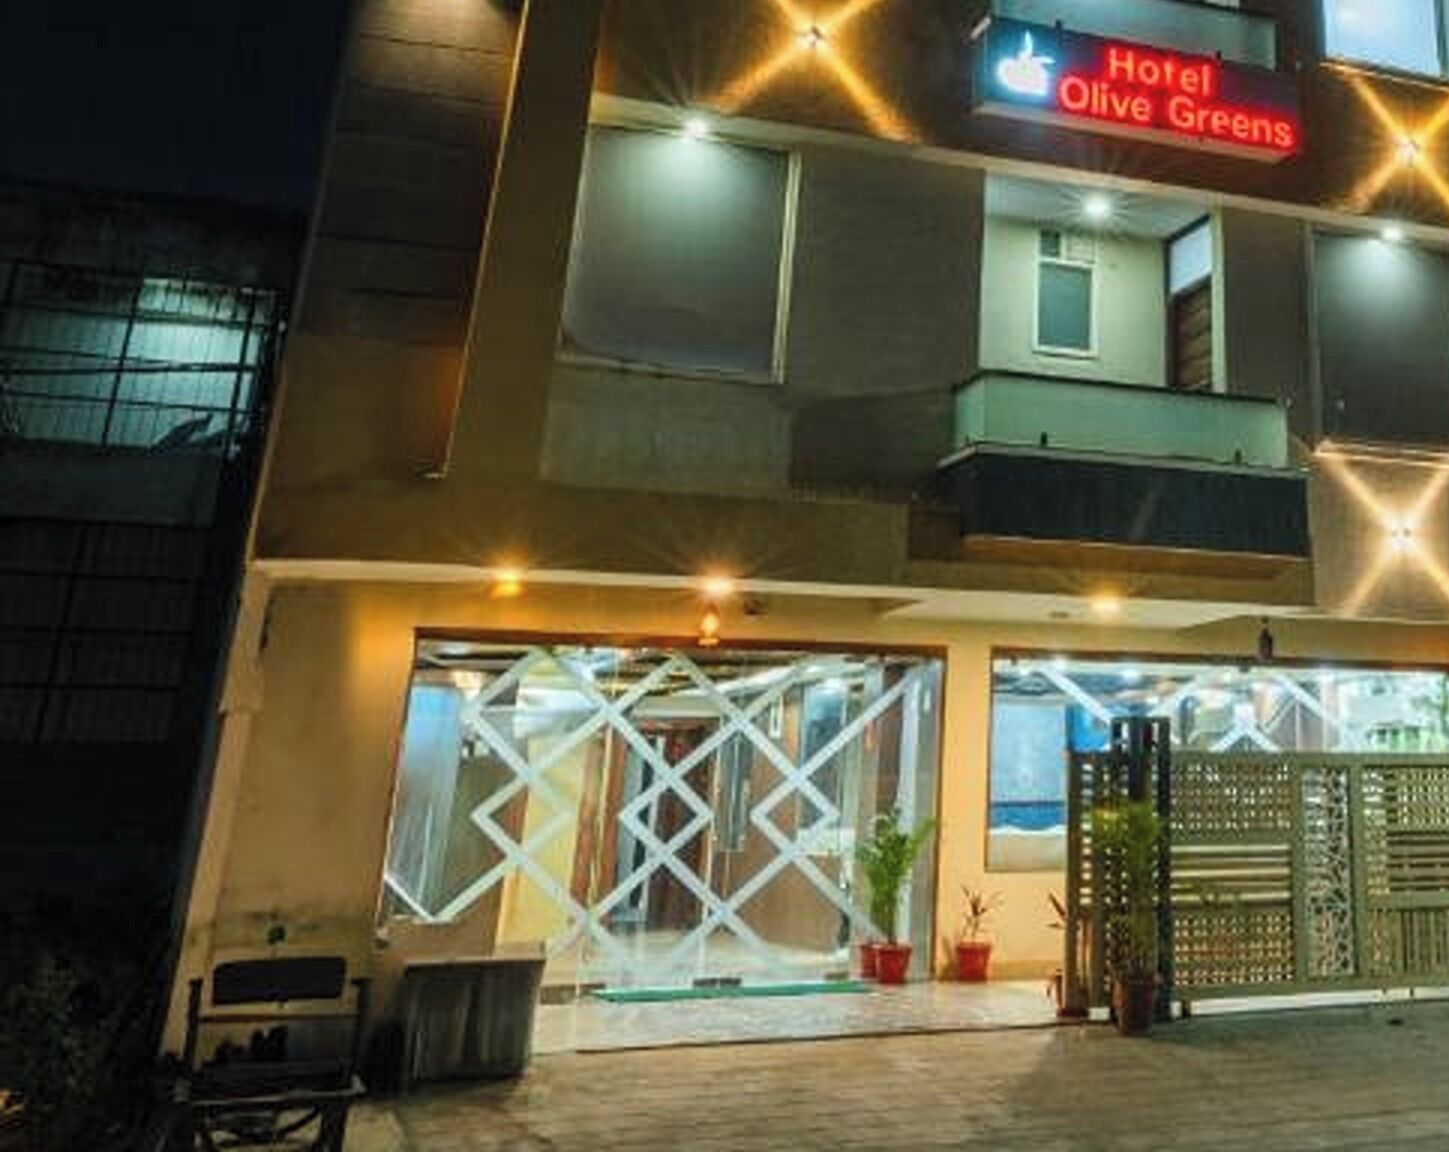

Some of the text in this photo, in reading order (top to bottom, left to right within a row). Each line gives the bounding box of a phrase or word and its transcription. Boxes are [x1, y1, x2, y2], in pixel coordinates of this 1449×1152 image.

[1109, 47, 1211, 96] Hotel
[1059, 76, 1294, 147] Olive Greens
